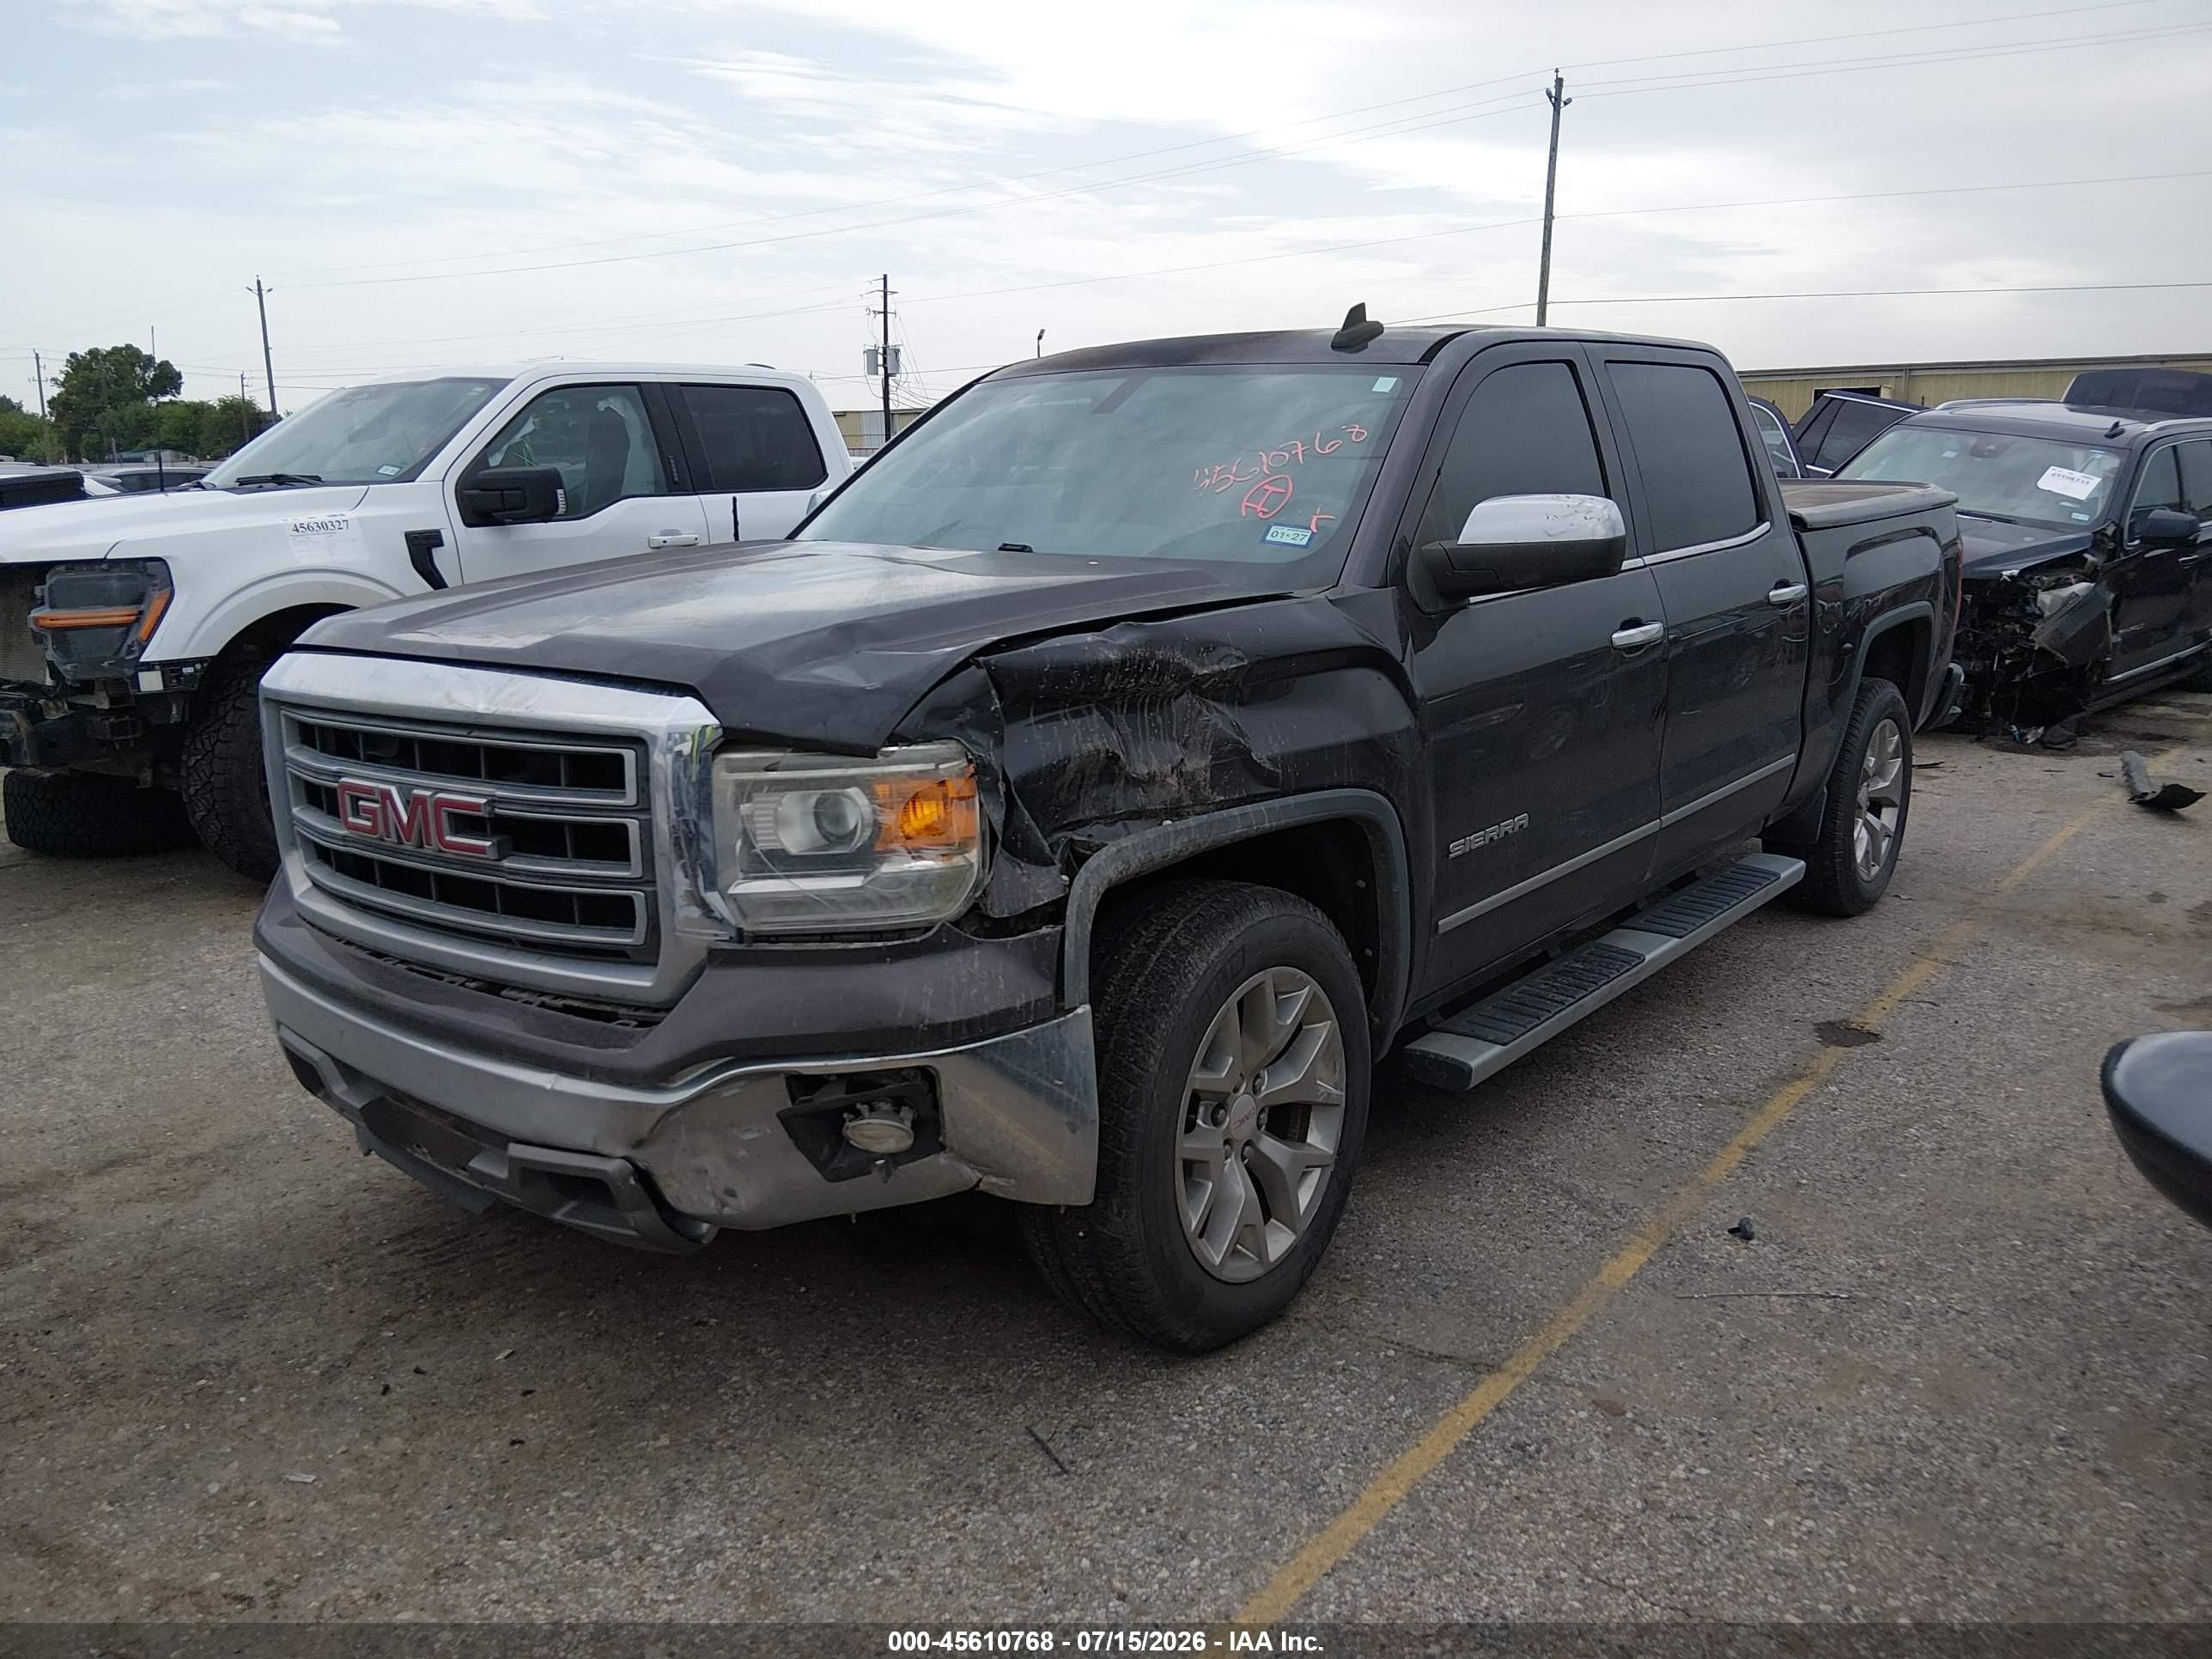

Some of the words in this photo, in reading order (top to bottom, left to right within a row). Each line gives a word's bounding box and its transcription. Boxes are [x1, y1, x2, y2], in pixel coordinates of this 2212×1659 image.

[292, 520, 349, 533] 45630327
[337, 776, 495, 859] GMC
[1448, 812, 1530, 860] SIERRA
